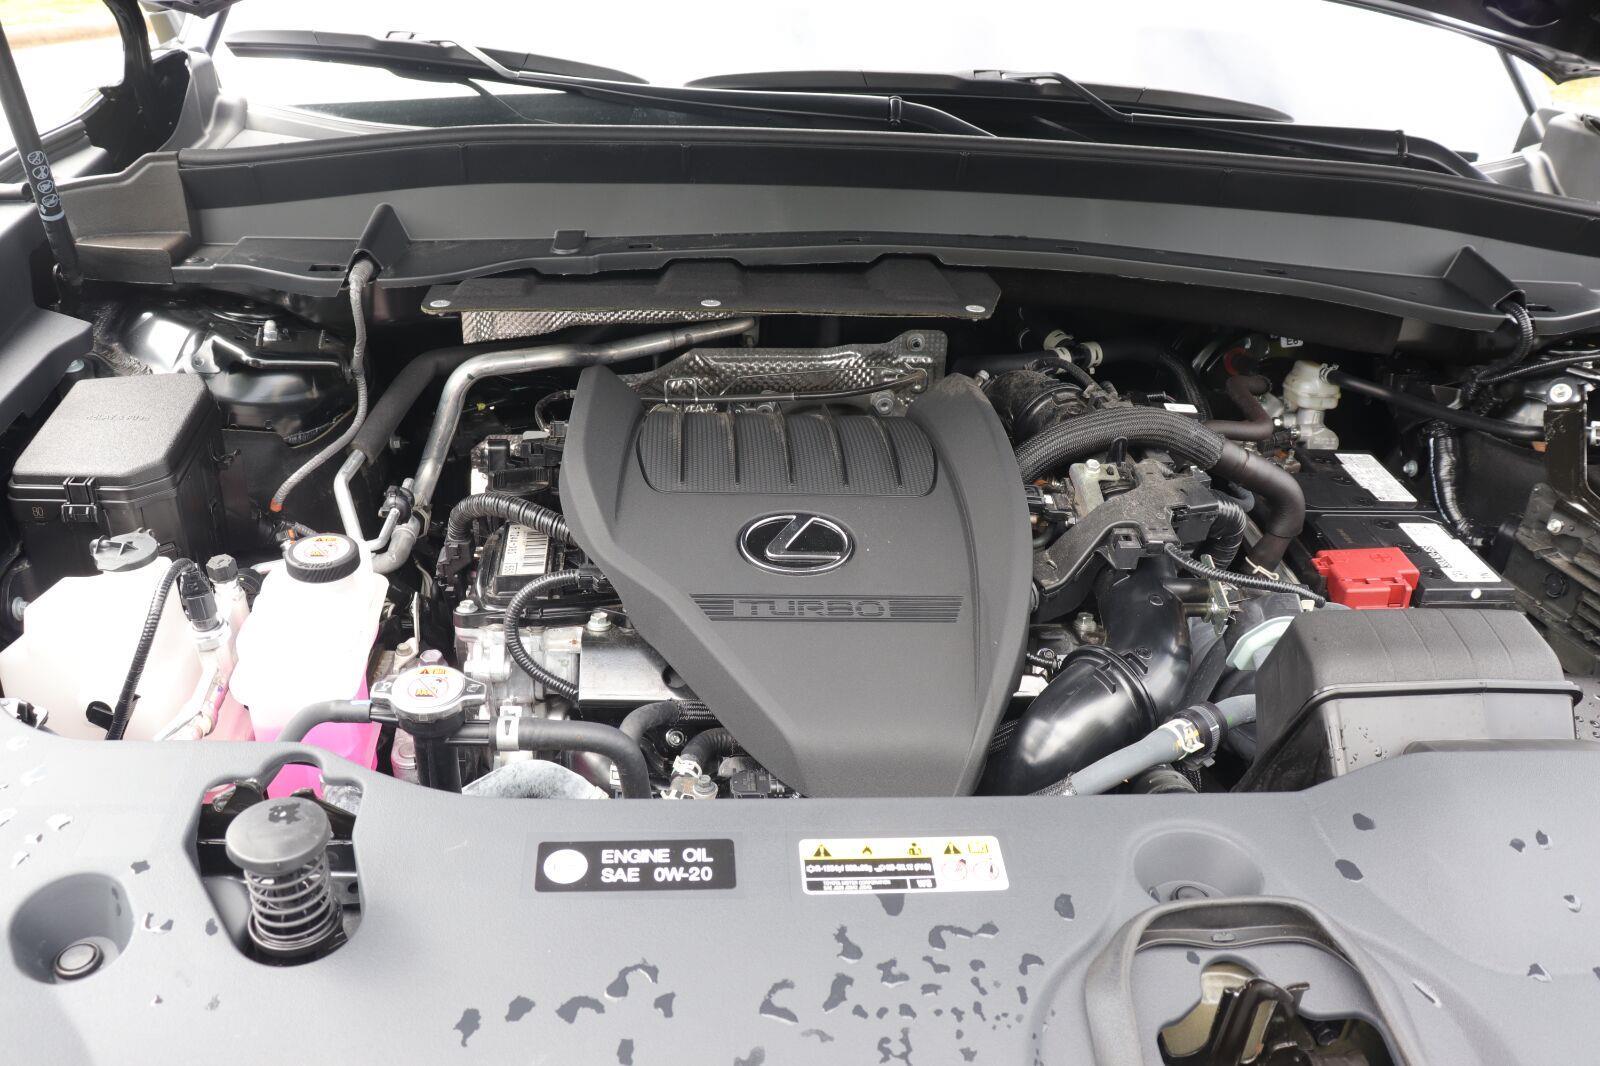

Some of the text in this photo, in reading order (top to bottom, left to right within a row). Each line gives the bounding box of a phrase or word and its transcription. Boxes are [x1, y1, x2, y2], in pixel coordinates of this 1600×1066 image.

[736, 600, 886, 617] TURBO
[601, 847, 714, 864] ENGINE OIL
[600, 866, 713, 883] SAE 0W-20
